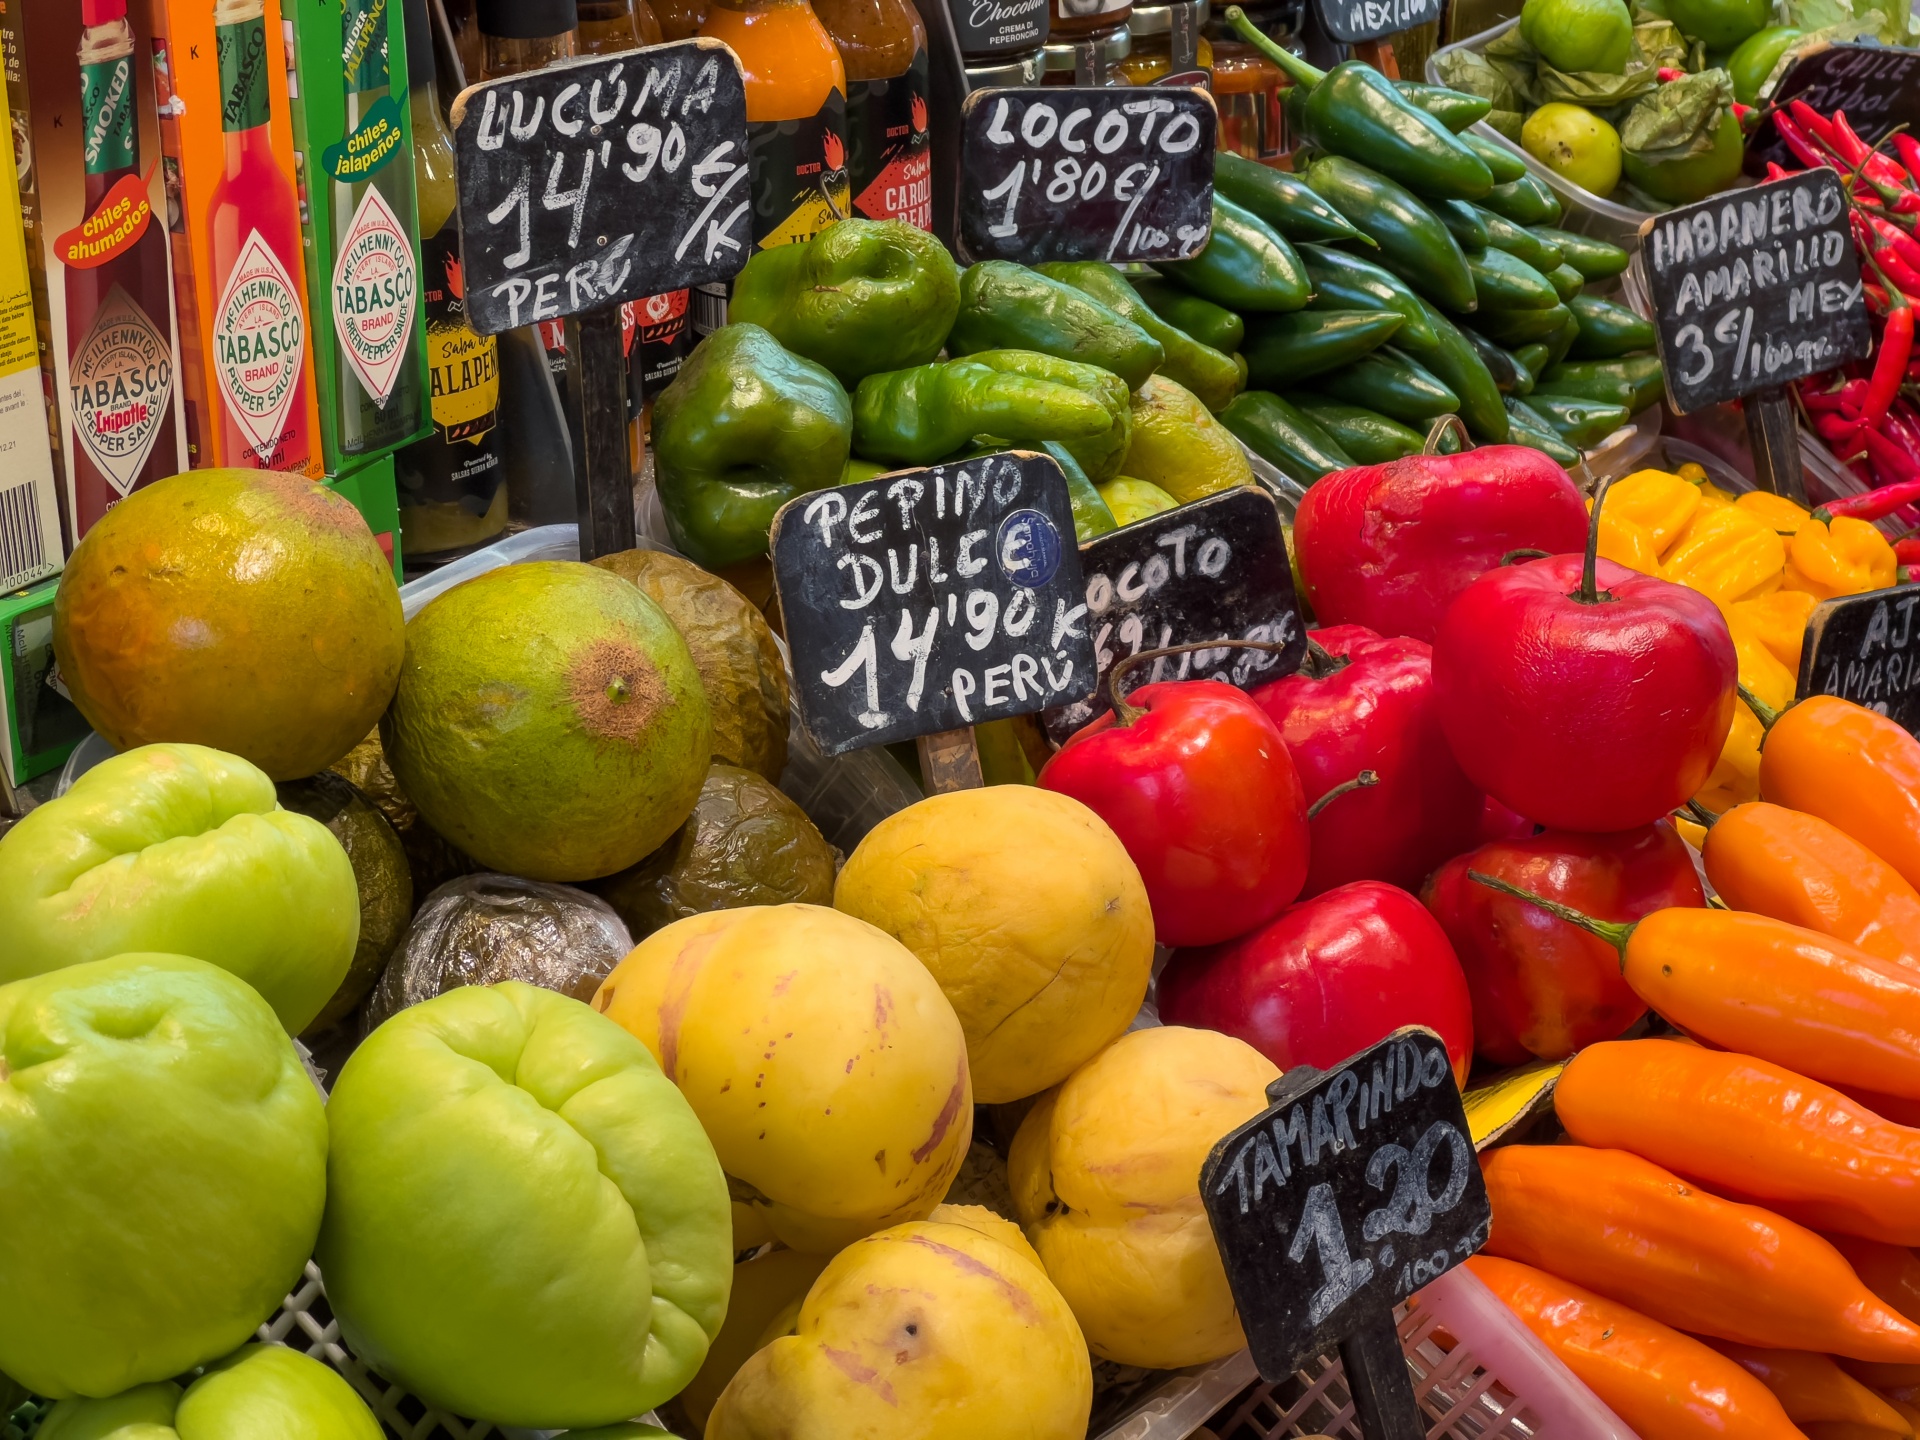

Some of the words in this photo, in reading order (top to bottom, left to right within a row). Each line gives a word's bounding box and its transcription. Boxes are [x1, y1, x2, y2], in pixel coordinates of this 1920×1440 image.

[342, 10, 367, 63] MILDER
[989, 28, 1039, 45] PEPERONCINO
[999, 22, 1026, 34] CREMA
[1026, 20, 1034, 30] DI
[190, 46, 199, 60] K
[223, 27, 265, 125] TABASCO
[1824, 50, 1917, 80] CHILE
[53, 115, 63, 129] K
[85, 61, 128, 166] SMOKED
[476, 56, 719, 152] LUCÚMA
[986, 97, 1200, 154] LOCOTO
[335, 126, 401, 175] jalapeños
[347, 118, 388, 153] chiles
[68, 200, 149, 259] ahumados
[83, 197, 131, 237] chiles
[356, 224, 370, 235] MADE
[1653, 186, 1842, 272] HABANERO
[238, 271, 254, 283] MADE
[375, 256, 395, 272] ISLAND
[259, 304, 281, 320] ISLAND
[337, 266, 412, 314] TABASCO
[1788, 278, 1864, 324] MEX
[218, 315, 300, 365] TABASCO
[346, 317, 364, 355] GREEN
[363, 334, 397, 360] PEPPER
[394, 302, 407, 338] SAUCE
[361, 312, 394, 331] BRAND
[71, 359, 168, 411] TABASCO
[227, 368, 264, 412] PEPPER
[269, 354, 294, 408] SAUCE
[245, 362, 279, 382] BRAND
[430, 343, 499, 397] ALAPEÑ
[110, 400, 132, 412] BRAND
[272, 448, 285, 466] ml
[804, 457, 1023, 548] PEPINO
[4, 566, 43, 590] 100044
[837, 521, 1031, 610] DULCE
[1086, 524, 1231, 613] OCOTO
[1215, 1038, 1448, 1214] TAMARINDO
[1394, 1249, 1449, 1295] 100
